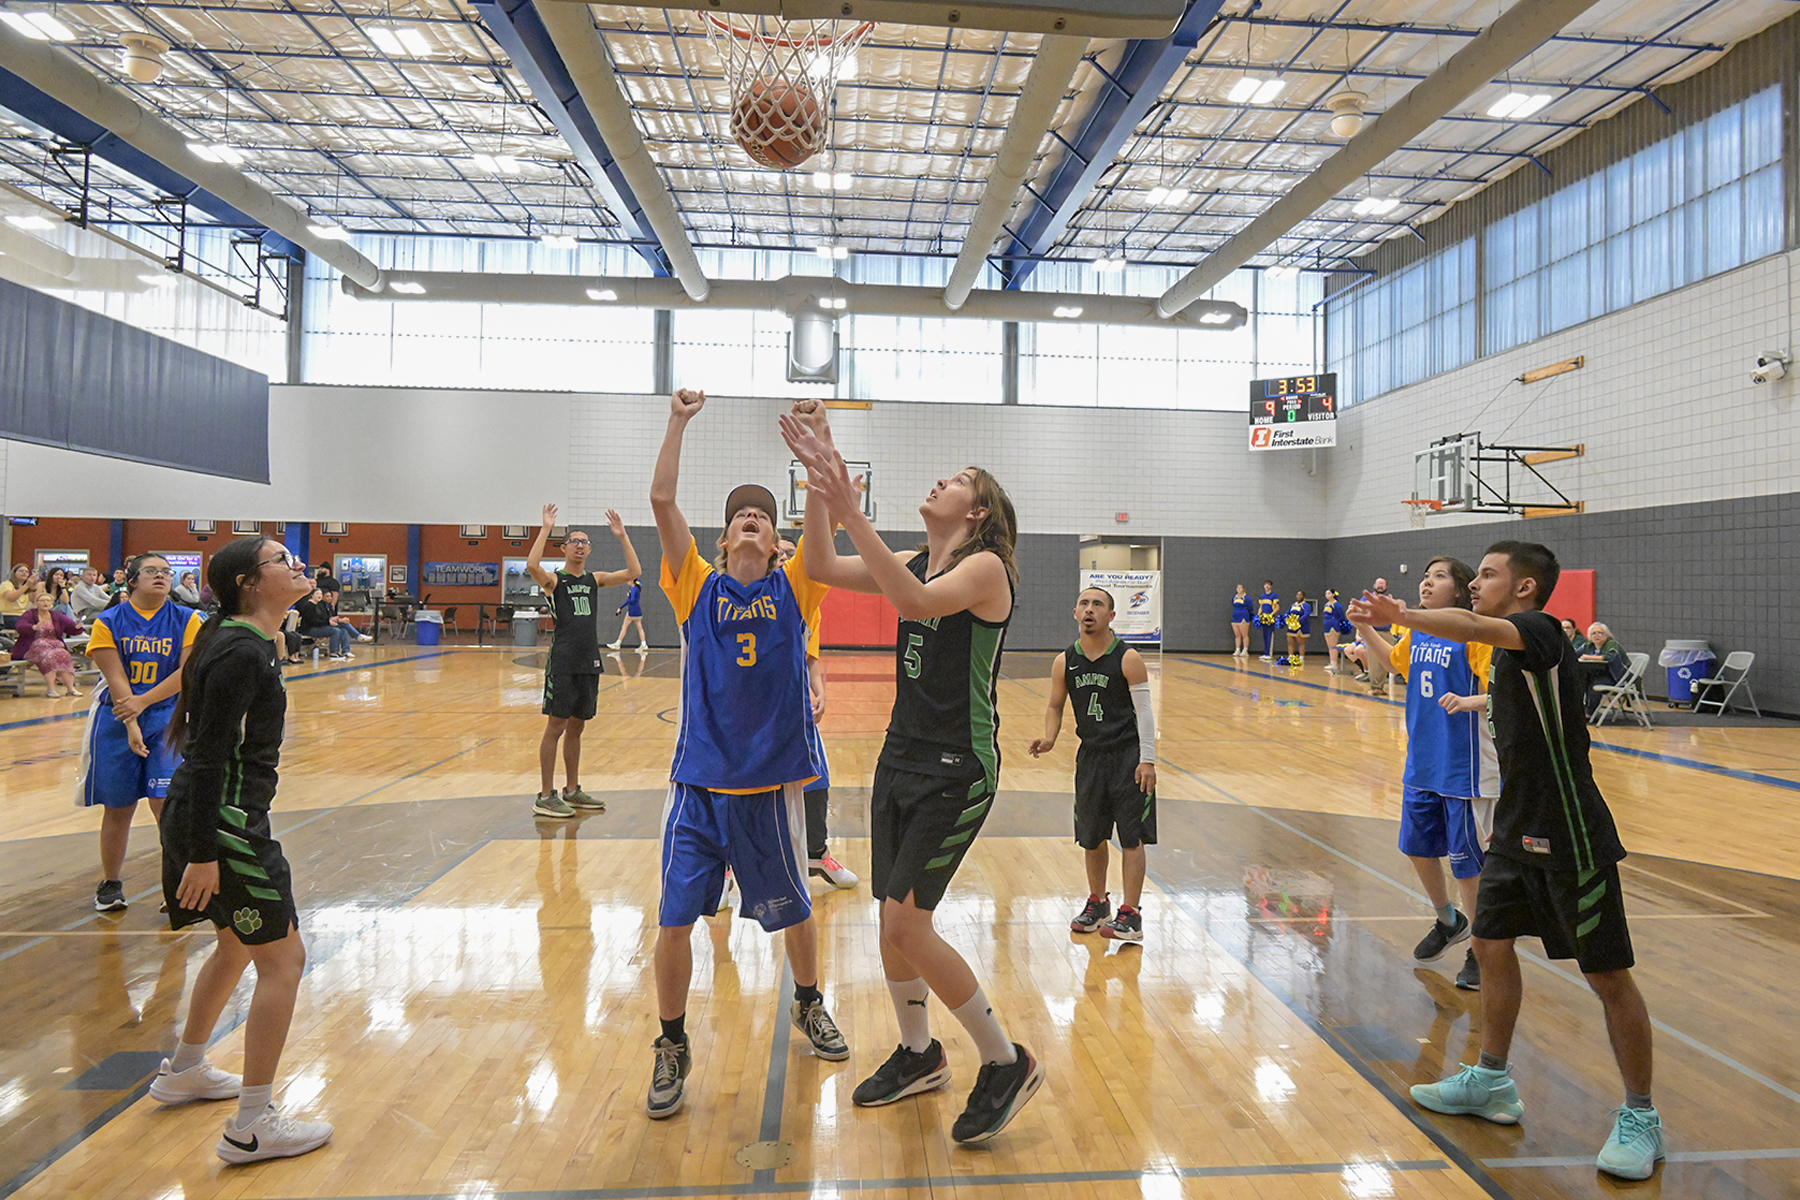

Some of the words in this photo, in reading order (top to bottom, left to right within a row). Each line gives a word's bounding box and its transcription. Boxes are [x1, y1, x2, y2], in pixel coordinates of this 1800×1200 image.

[1278, 376, 1315, 394] 3:53
[1265, 400, 1275, 416] 9
[1322, 396, 1332, 412] 4
[1254, 416, 1274, 425] HOME
[1287, 409, 1296, 422] 0
[1308, 412, 1335, 421] VISITOR
[1271, 437, 1314, 447] Interstate
[1314, 435, 1334, 445] Bank
[1273, 430, 1294, 438] First
[435, 564, 488, 573] TEAMWORK
[572, 597, 591, 615] 10
[717, 596, 776, 622] TITANS
[121, 637, 172, 656] TITANS
[736, 632, 756, 666] 3
[904, 633, 923, 678] 5
[1410, 645, 1452, 668] TITANS
[130, 661, 158, 684] 00
[1075, 673, 1109, 688] AMPHI
[1421, 670, 1434, 698] 6
[1087, 692, 1104, 721] 4
